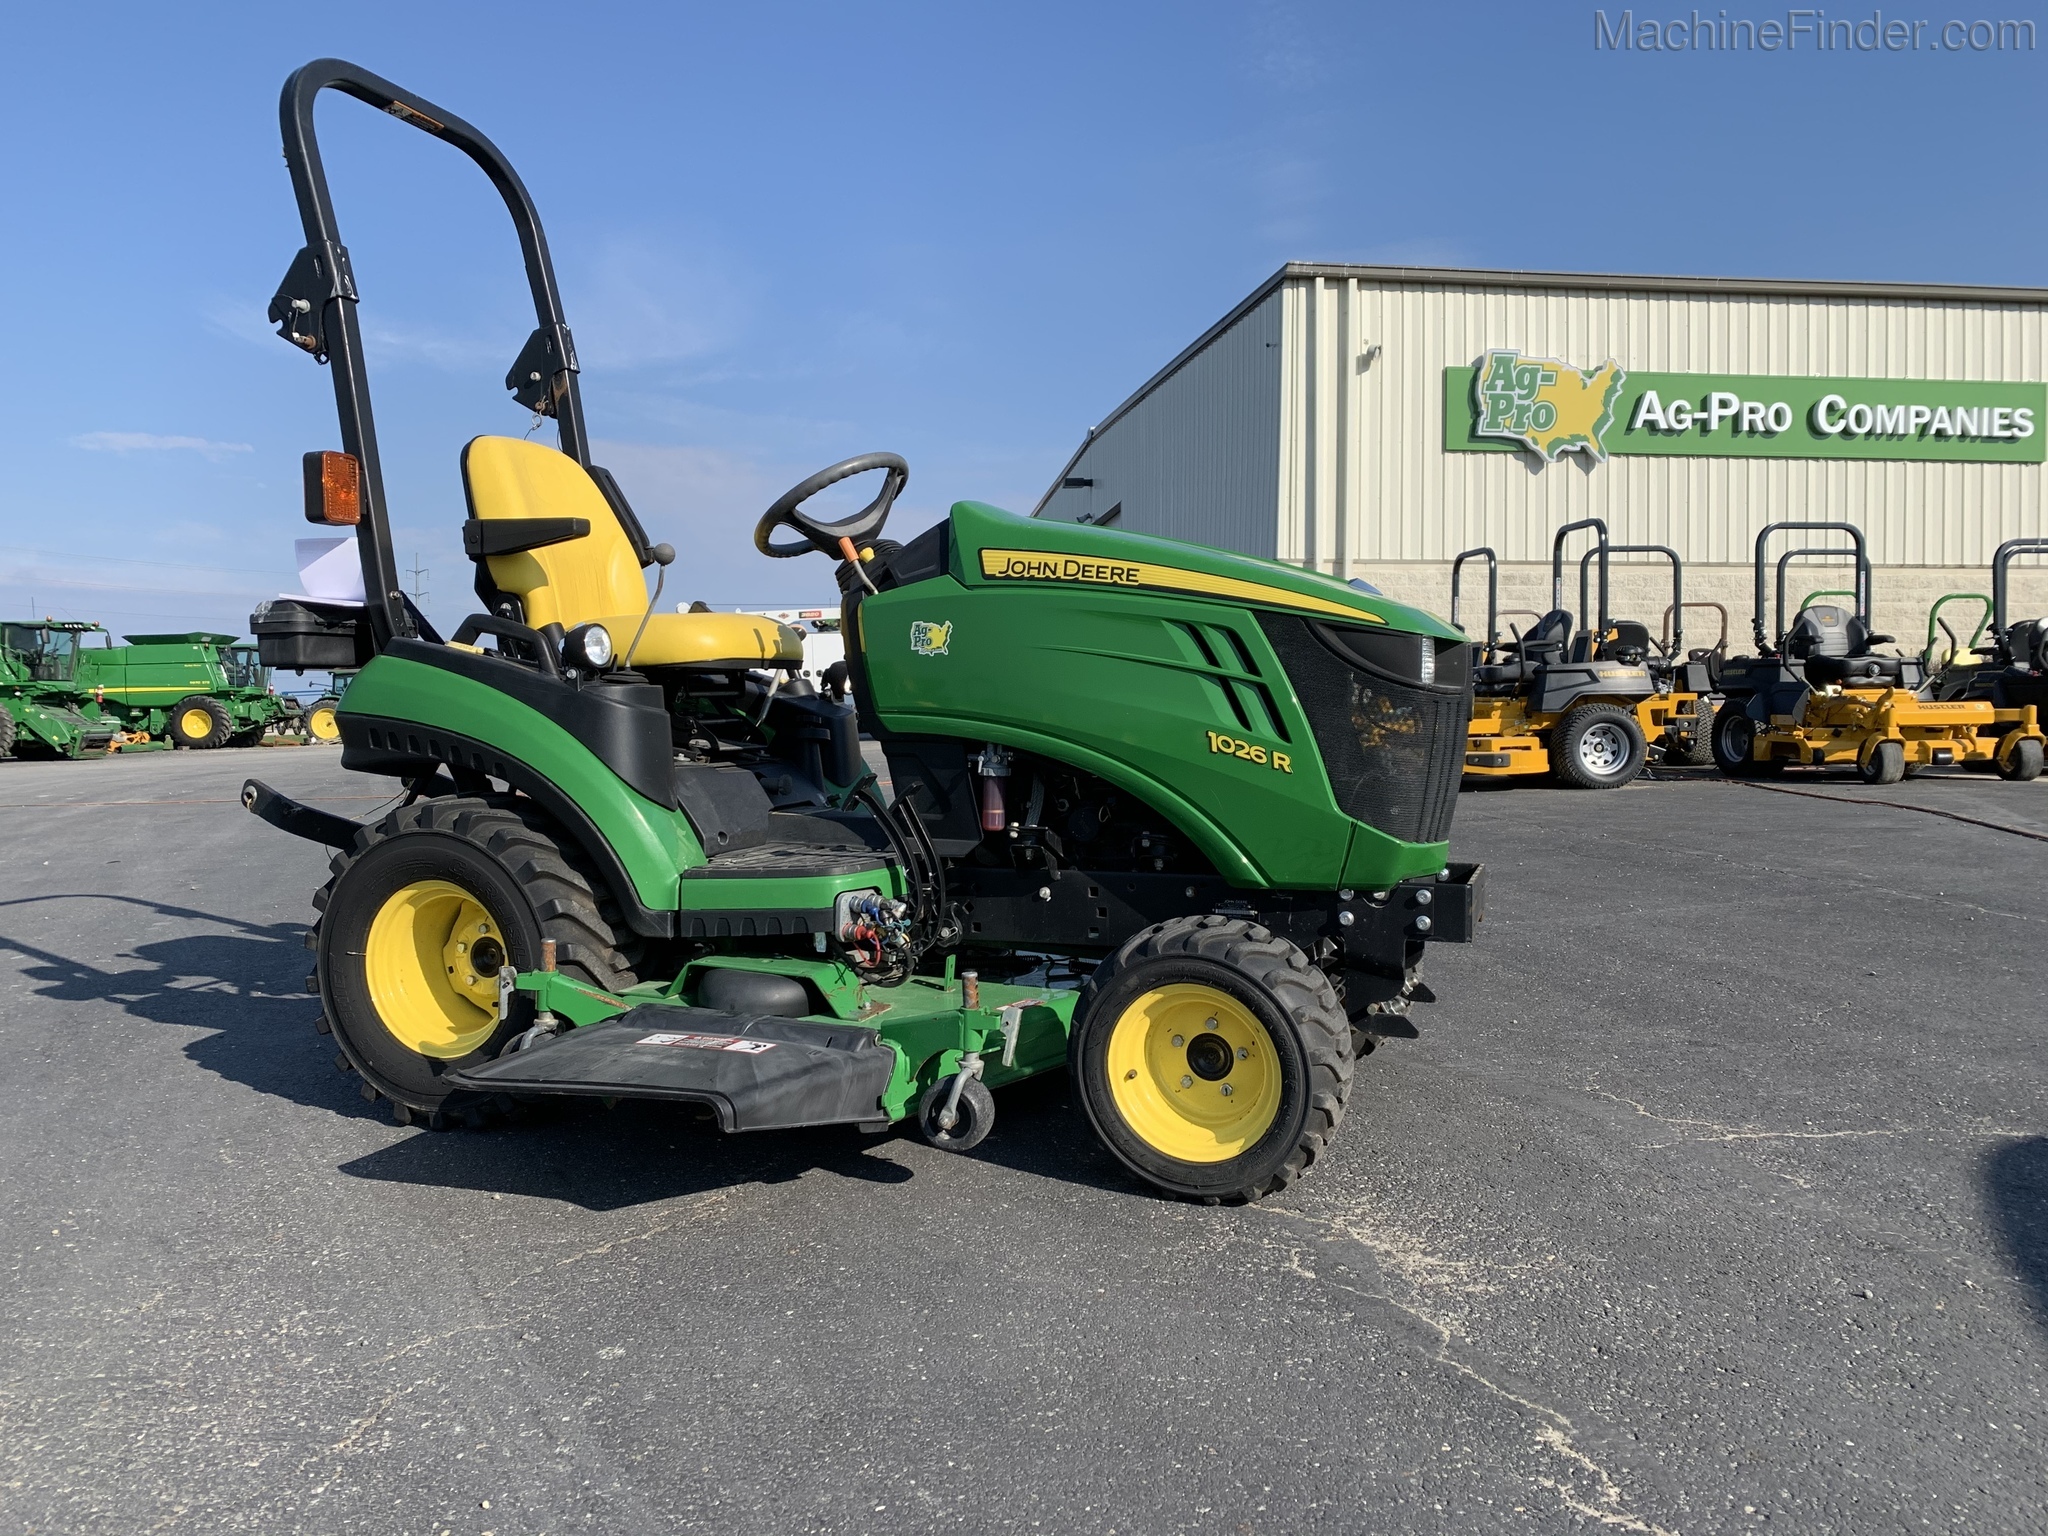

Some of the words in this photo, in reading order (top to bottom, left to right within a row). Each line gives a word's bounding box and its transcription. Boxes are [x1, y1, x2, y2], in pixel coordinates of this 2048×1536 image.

[1484, 354, 1557, 402] Ag-
[1483, 392, 1557, 432] Pro
[998, 558, 1058, 577] JOHN
[1063, 559, 1140, 583] DEERE
[1206, 730, 1268, 765] 1026
[1271, 750, 1294, 774] R
